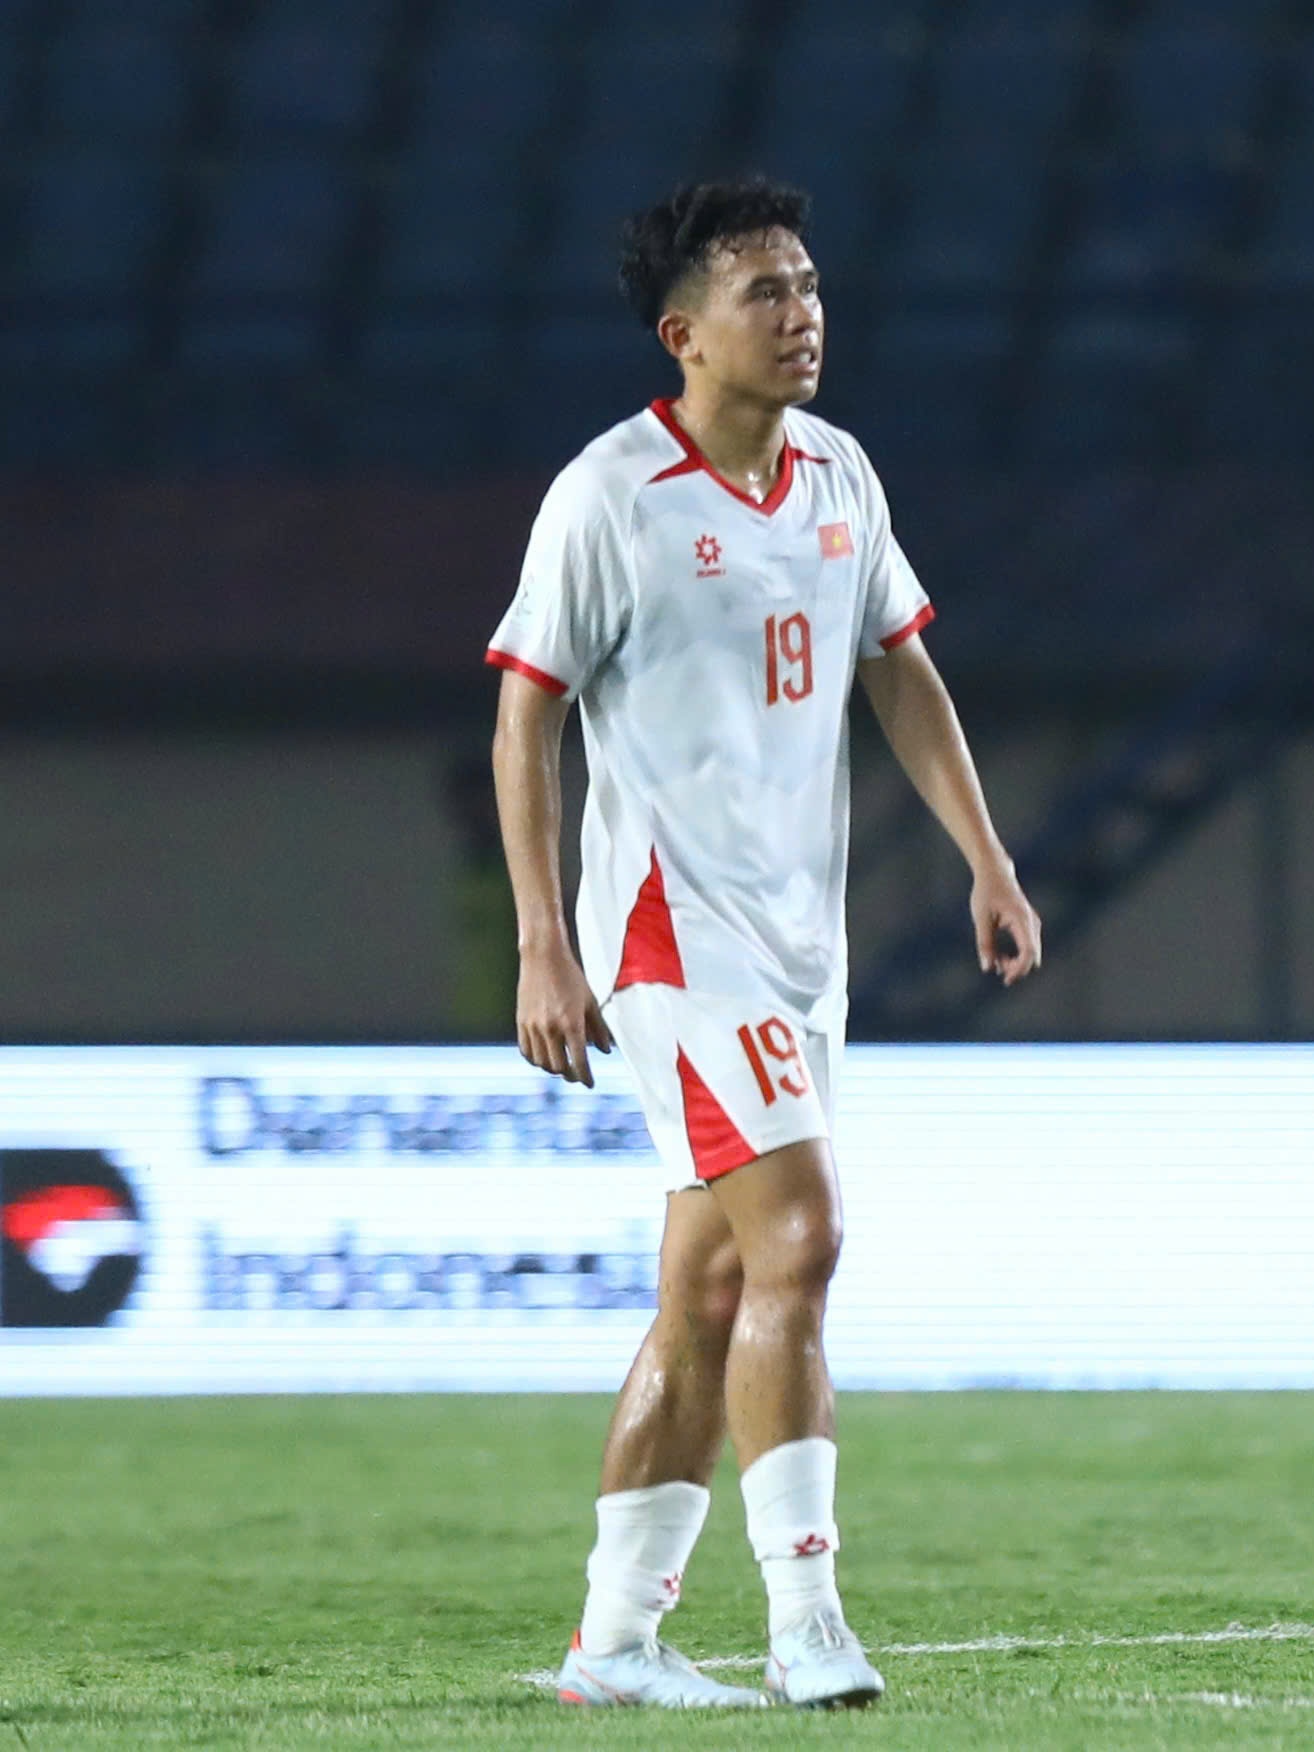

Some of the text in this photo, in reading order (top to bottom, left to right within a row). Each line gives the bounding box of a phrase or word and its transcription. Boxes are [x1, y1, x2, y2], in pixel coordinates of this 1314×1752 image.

[765, 612, 813, 707] 19
[737, 1016, 809, 1107] 19
[200, 1076, 655, 1156] Dananta
[202, 1222, 659, 1310] Indonesi
